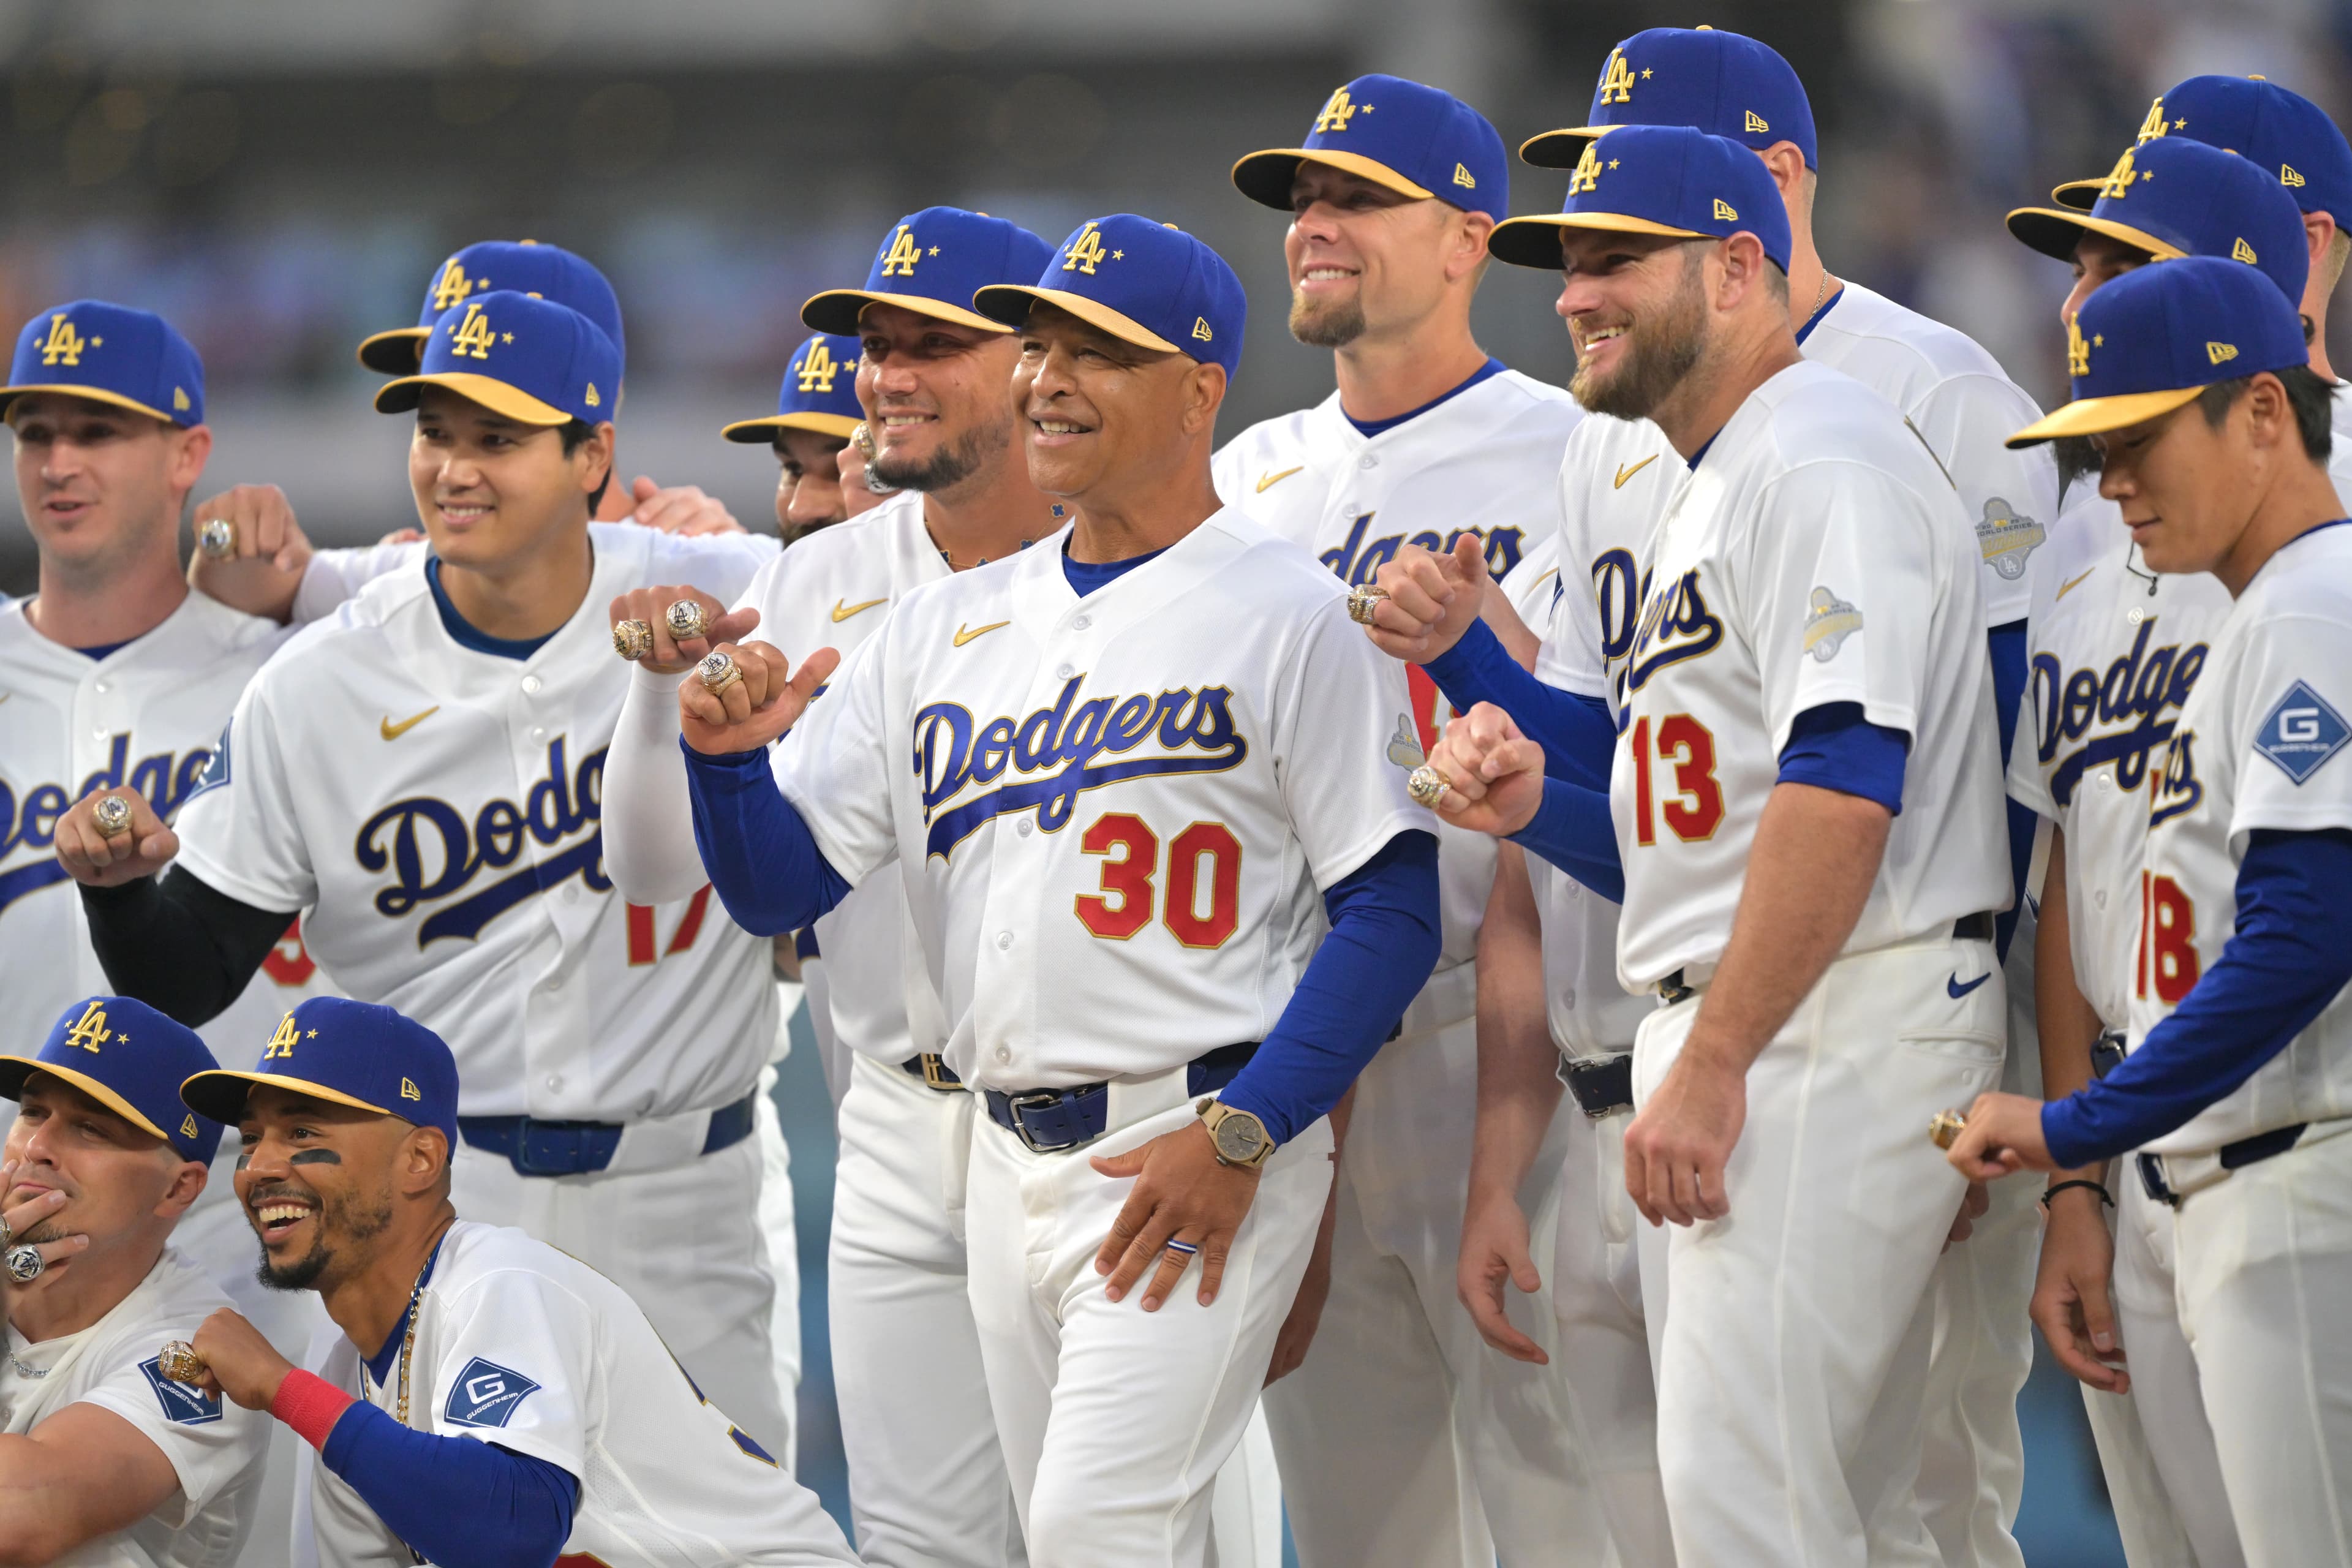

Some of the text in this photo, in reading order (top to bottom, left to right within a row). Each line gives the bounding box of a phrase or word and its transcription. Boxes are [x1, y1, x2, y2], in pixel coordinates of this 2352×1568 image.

[1600, 48, 1635, 105] LA
[1316, 85, 1356, 134] LA
[2138, 96, 2169, 145] LA
[1569, 140, 1603, 197] LA
[2100, 146, 2138, 199] LA
[881, 224, 922, 277] LA
[1062, 222, 1107, 275] LA
[433, 257, 473, 311] LA
[42, 314, 85, 366] LA
[452, 303, 496, 360] LA
[798, 336, 838, 393] LA
[2002, 557, 2018, 573] LA
[913, 671, 1249, 872] Dodgers
[1632, 712, 1725, 847] 13
[1073, 812, 1243, 950] 30
[64, 1001, 113, 1054] LA
[263, 1009, 301, 1061] LA
[158, 1381, 205, 1416] GUGGENHEIM
[466, 1372, 506, 1404] G
[466, 1392, 519, 1420] GUGGENHEIM
